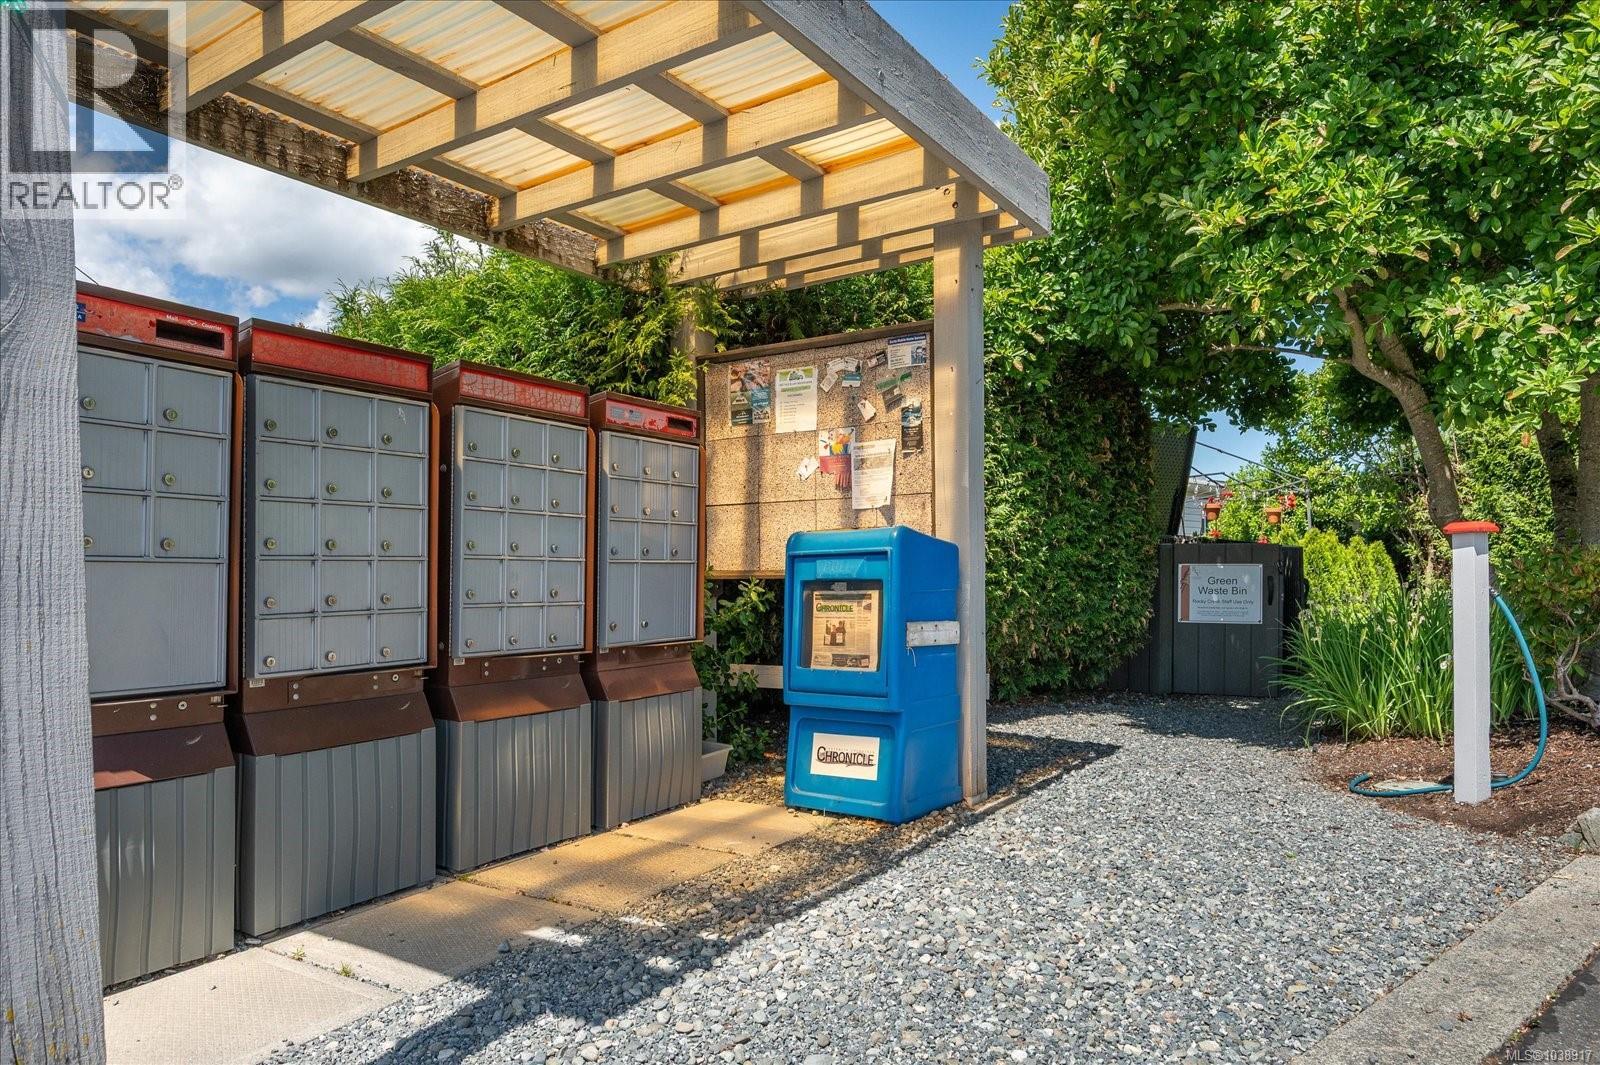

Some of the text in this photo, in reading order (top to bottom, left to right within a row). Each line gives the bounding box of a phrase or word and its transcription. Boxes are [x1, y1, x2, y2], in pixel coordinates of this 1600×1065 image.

[1207, 576, 1238, 585] Green
[1197, 586, 1248, 595] Waste Bin
[815, 602, 854, 613] CHRONICLE
